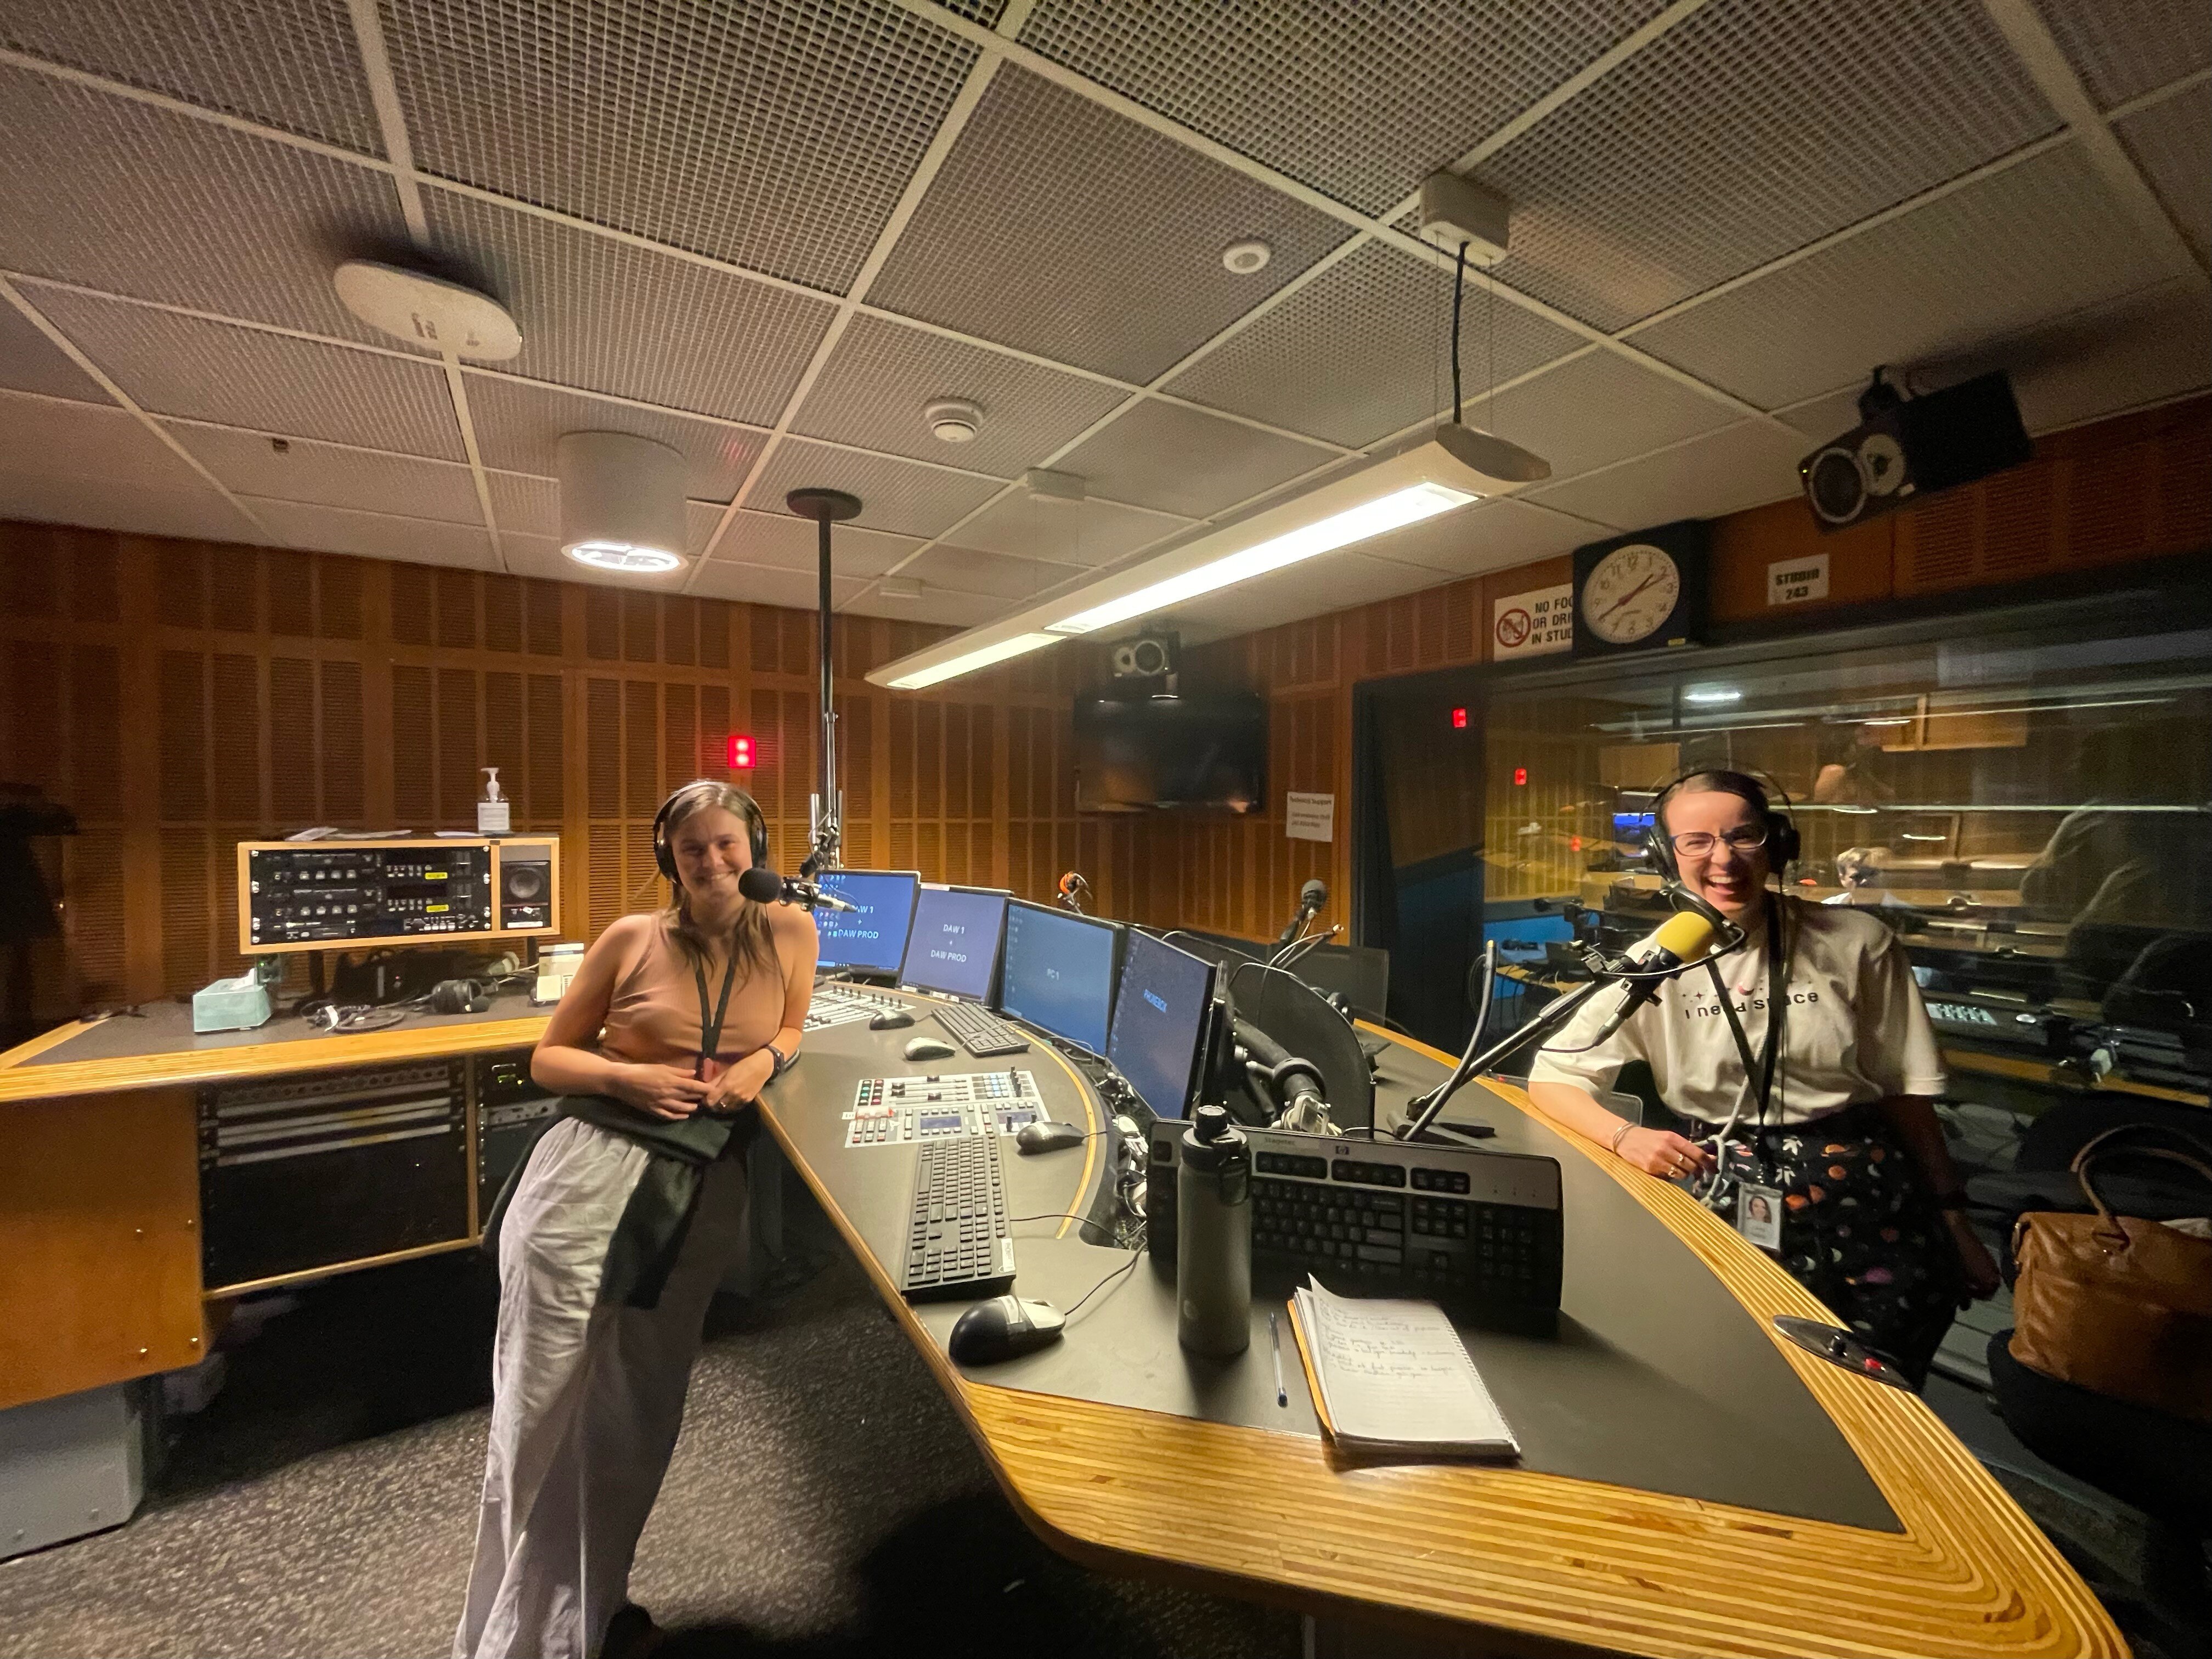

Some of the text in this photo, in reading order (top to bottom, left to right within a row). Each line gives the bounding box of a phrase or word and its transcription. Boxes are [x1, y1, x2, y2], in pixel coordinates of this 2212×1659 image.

[1627, 555, 1639, 571] 12
[1535, 596, 1573, 613] NO FOO
[1533, 612, 1572, 629] OR DRI
[1532, 628, 1572, 645] IN STUD
[870, 905, 874, 914] 1
[838, 928, 879, 939] DAW PROD
[943, 924, 966, 934] DAW 1
[930, 950, 967, 962] DAW PROD
[1697, 1001, 1747, 1018] ned
[1753, 992, 1819, 1010] sce
